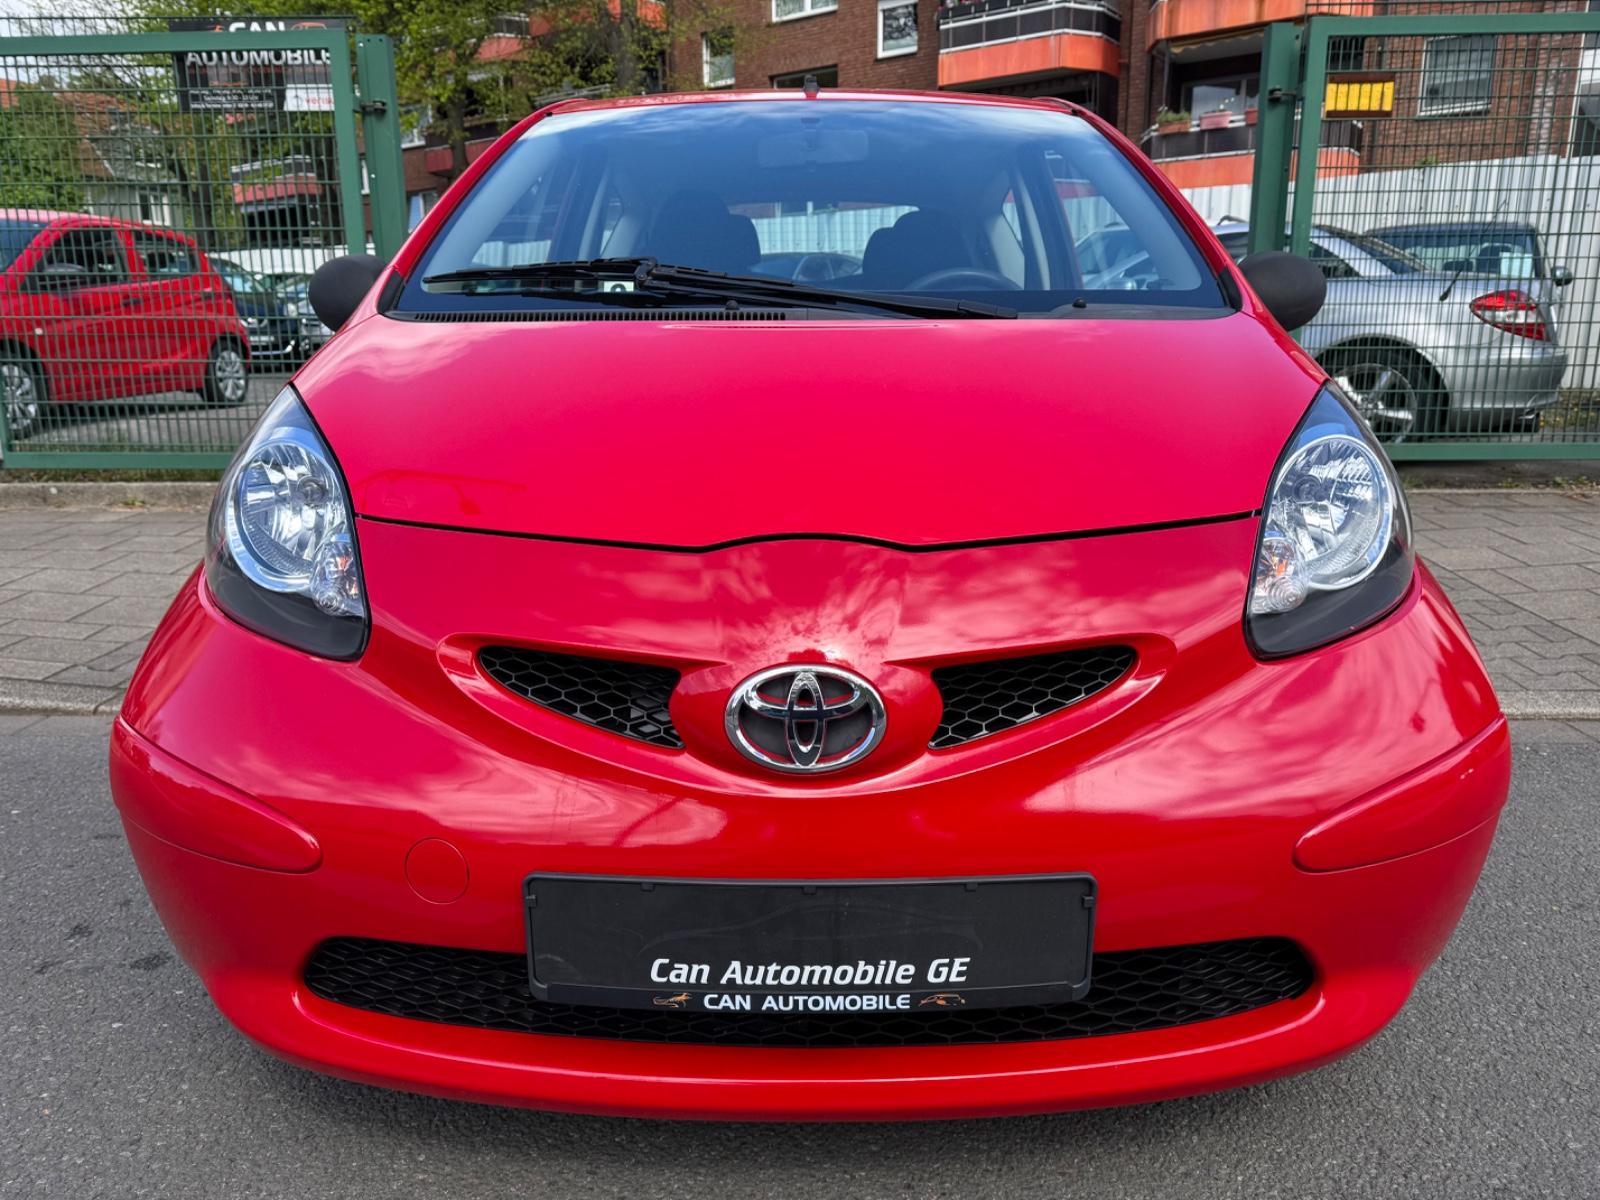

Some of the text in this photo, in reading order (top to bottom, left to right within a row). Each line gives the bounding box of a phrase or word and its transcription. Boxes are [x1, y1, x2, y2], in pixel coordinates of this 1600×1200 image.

[650, 957, 971, 986] Can Automobile GE
[703, 993, 911, 1011] CAN AUTOMOBILE
